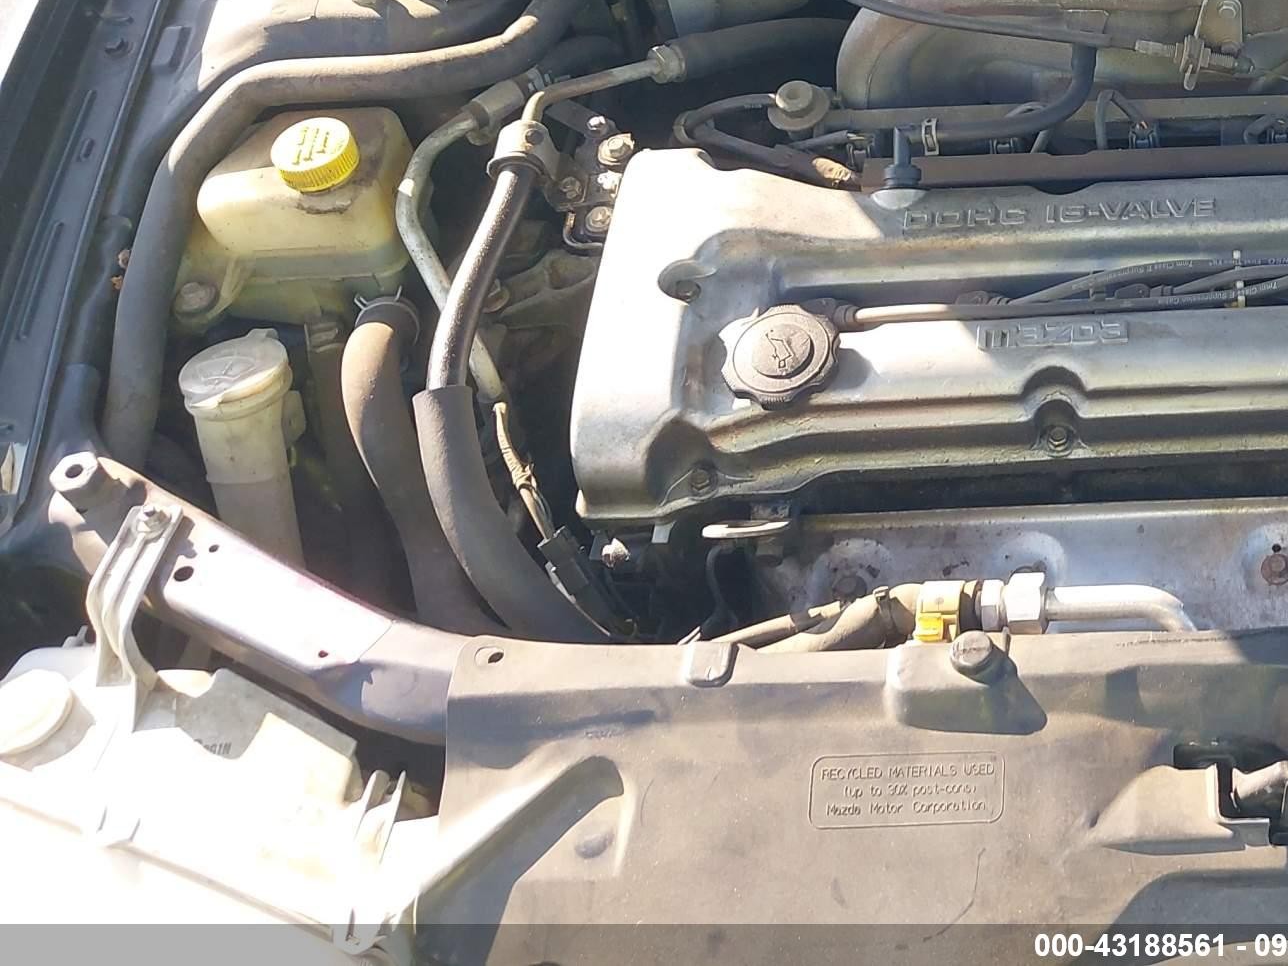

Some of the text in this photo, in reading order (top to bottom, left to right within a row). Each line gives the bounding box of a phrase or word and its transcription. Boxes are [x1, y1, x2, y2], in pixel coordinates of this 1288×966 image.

[903, 197, 1217, 232] DOHC 16-VALVE
[821, 762, 995, 781] RECYCLED MATERIALS USED
[870, 785, 882, 797] to
[826, 799, 987, 817] Mazda Motor Corporation
